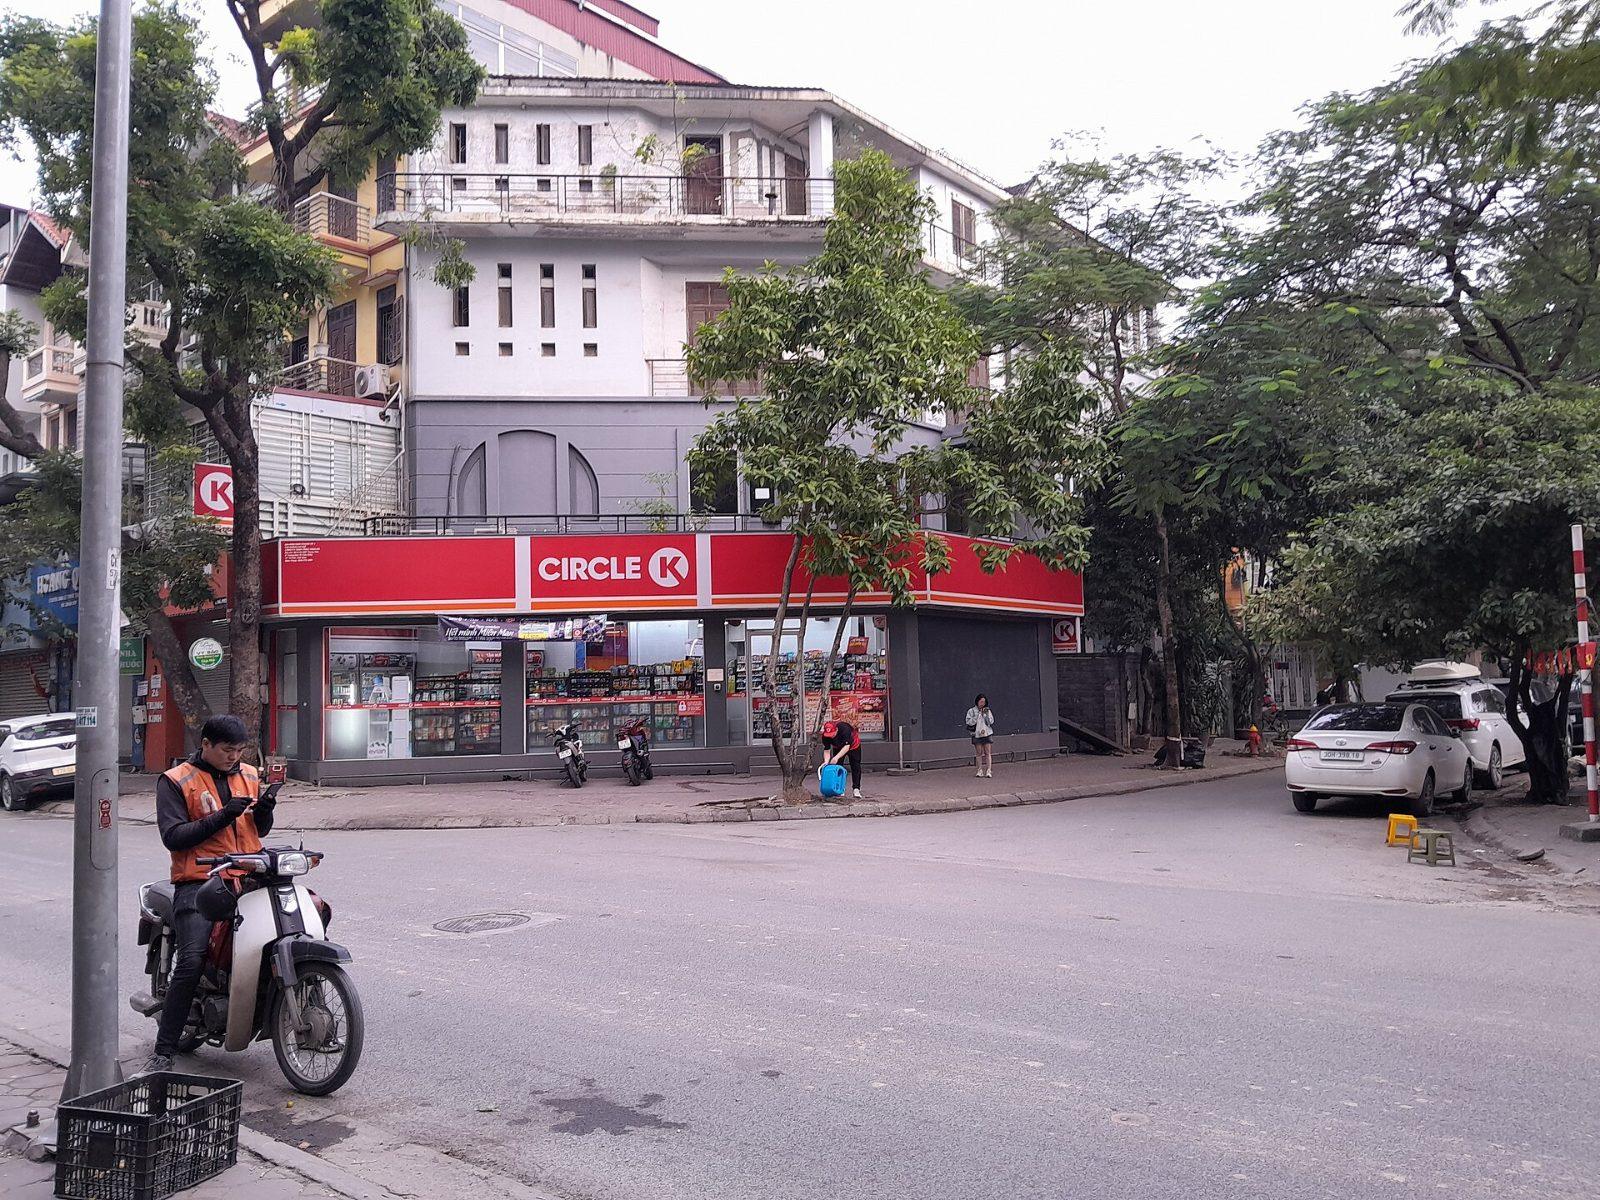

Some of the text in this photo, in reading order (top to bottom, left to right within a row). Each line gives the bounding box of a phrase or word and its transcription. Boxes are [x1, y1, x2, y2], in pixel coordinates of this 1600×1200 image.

[210, 480, 233, 505] K
[538, 554, 688, 586] CIRCLE K
